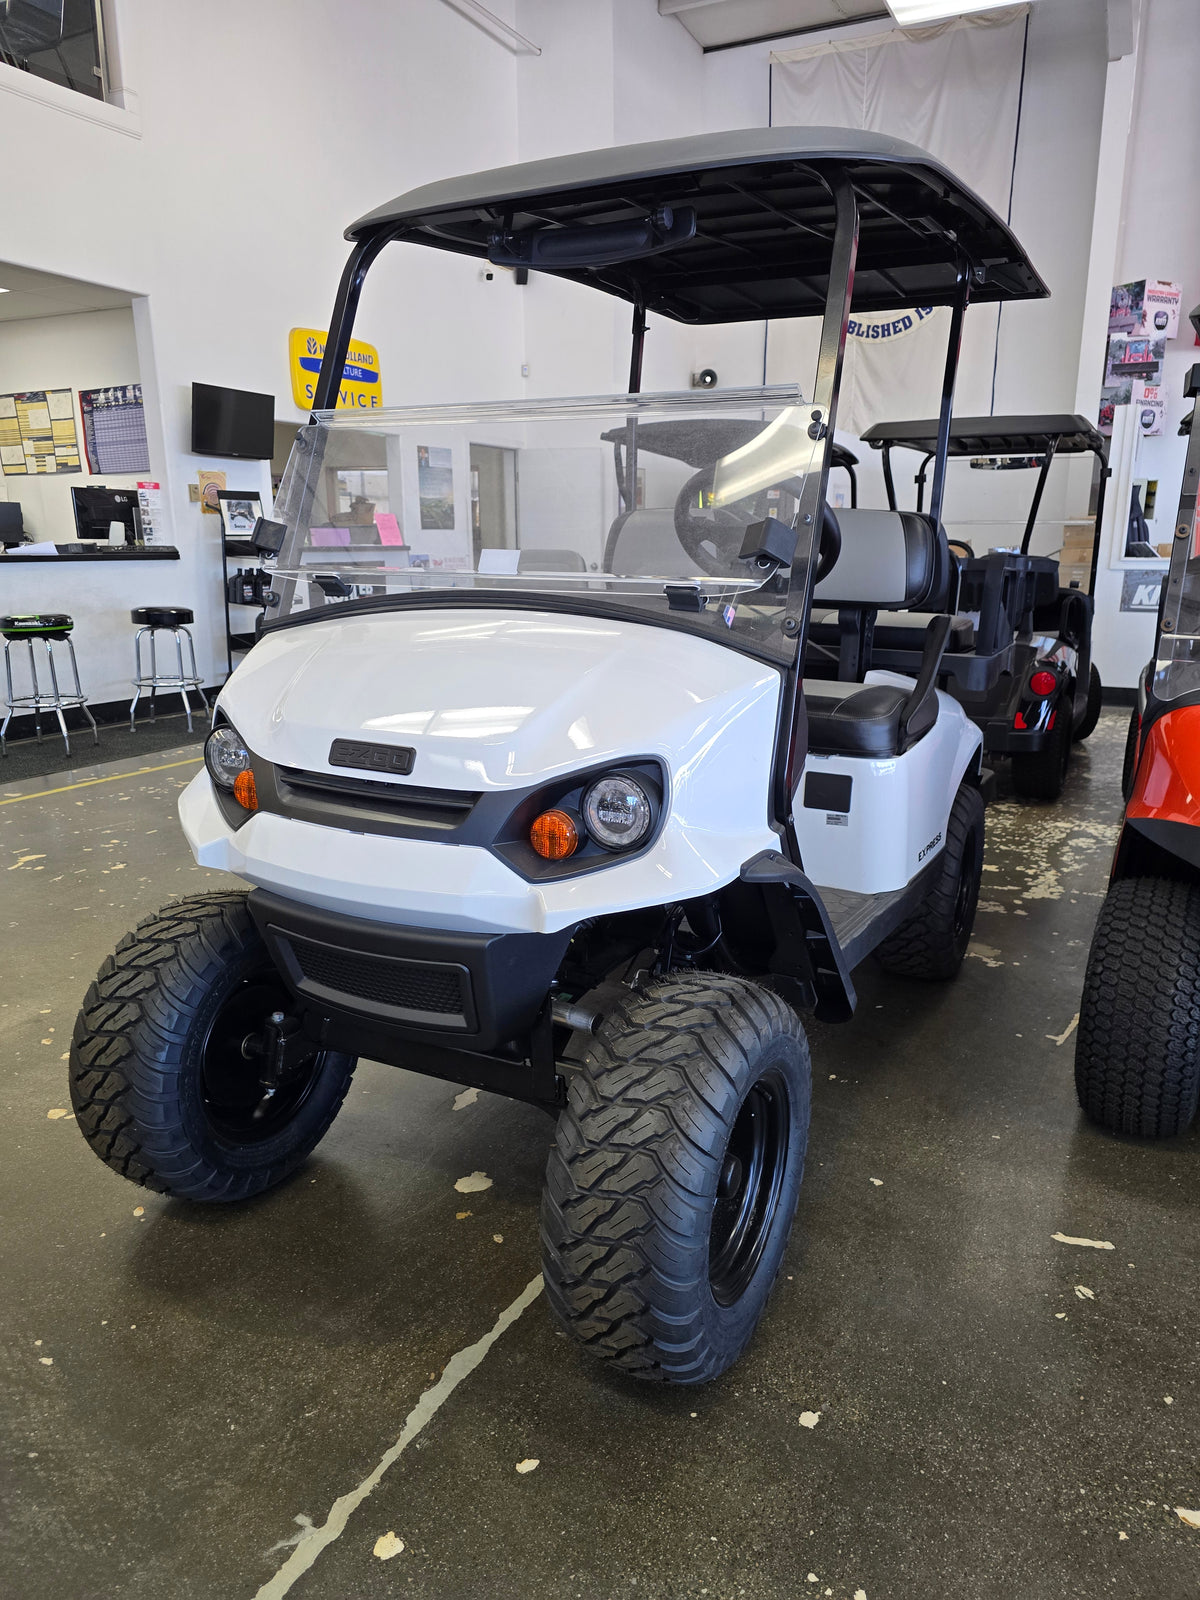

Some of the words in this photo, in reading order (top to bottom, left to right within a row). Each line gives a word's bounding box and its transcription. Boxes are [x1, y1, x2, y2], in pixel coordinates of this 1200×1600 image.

[1147, 295, 1179, 305] WARRANTY
[847, 315, 913, 339] BLISHED
[346, 351, 374, 365] OLLAND
[305, 384, 378, 408] SVICE
[1144, 387, 1158, 399] 0%
[1136, 399, 1164, 407] FINANCING
[918, 832, 942, 862] EXPRESS
